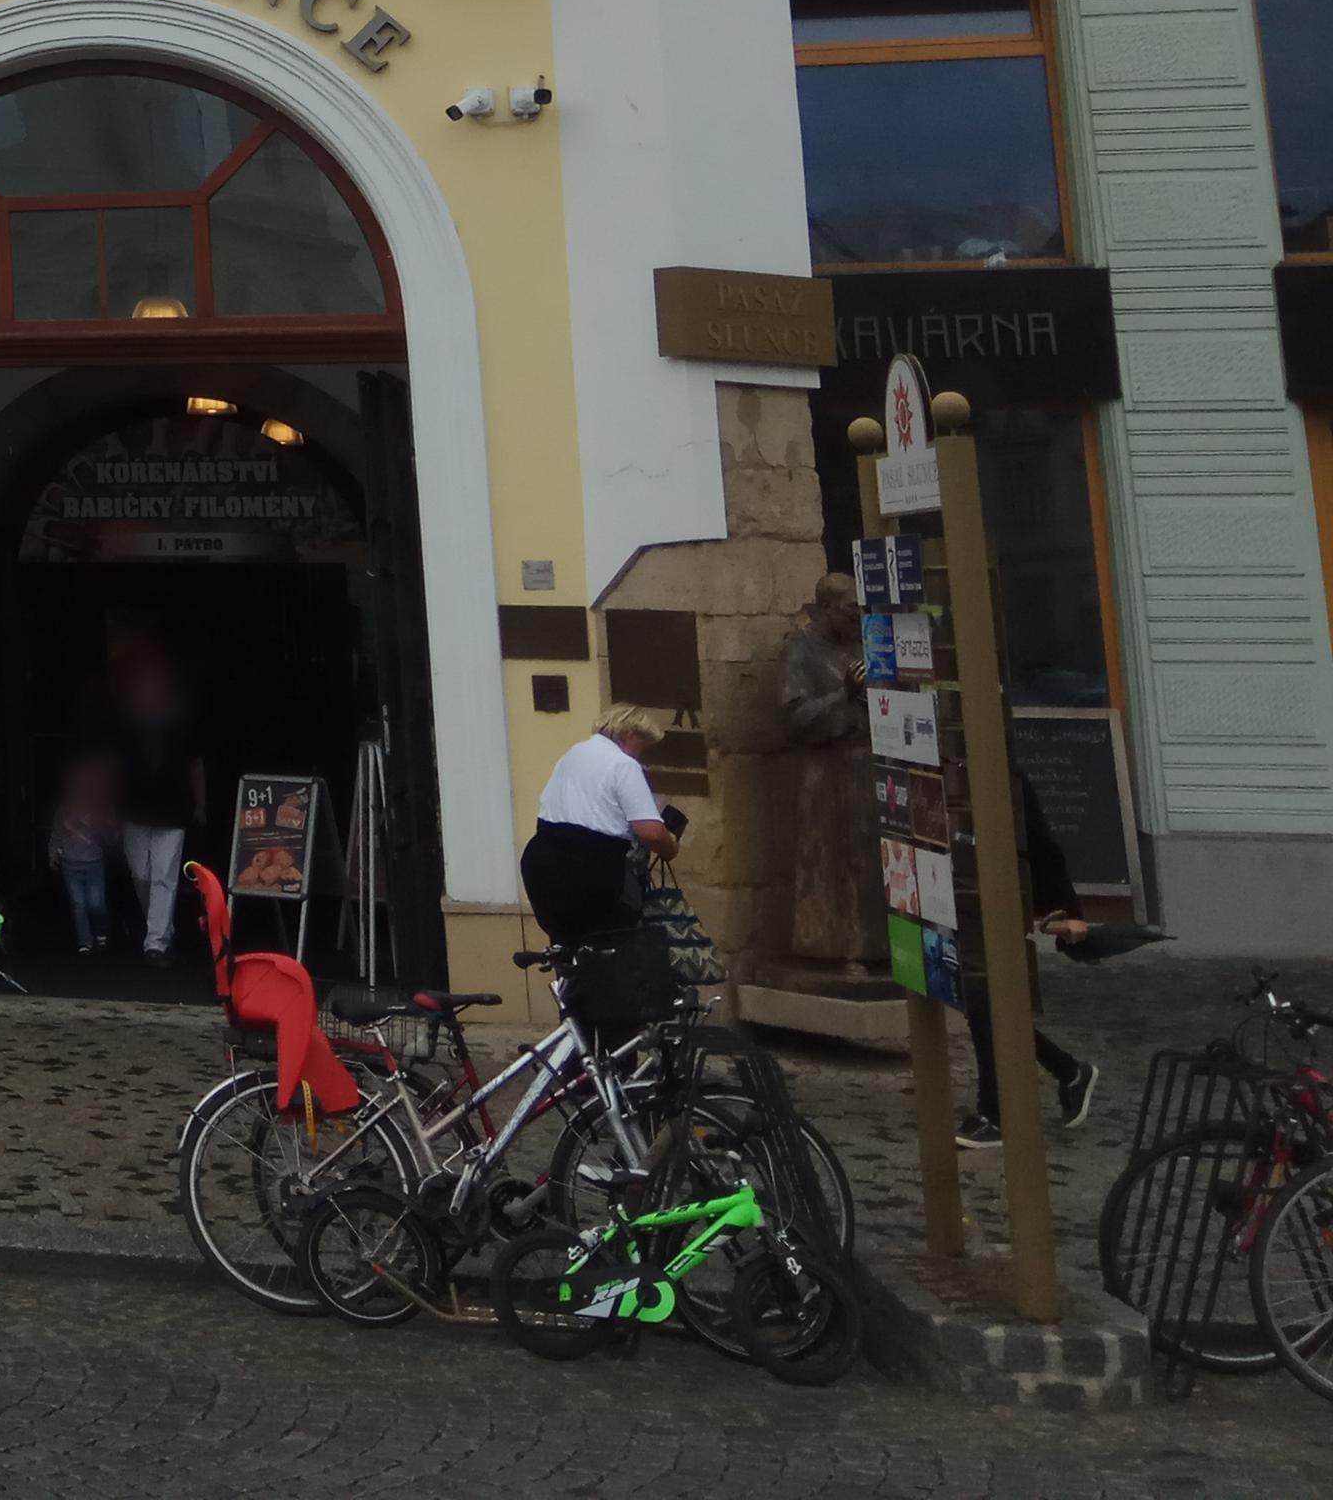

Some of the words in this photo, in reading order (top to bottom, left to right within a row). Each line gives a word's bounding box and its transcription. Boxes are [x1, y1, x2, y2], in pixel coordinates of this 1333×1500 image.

[716, 281, 806, 317] PASÁŽ
[707, 319, 821, 357] SLUNCE
[95, 455, 279, 484] KOŘENÁŘSTVÍ
[62, 491, 174, 519] BABIČKY
[174, 538, 223, 552] PATRO
[247, 785, 273, 808] 9+1
